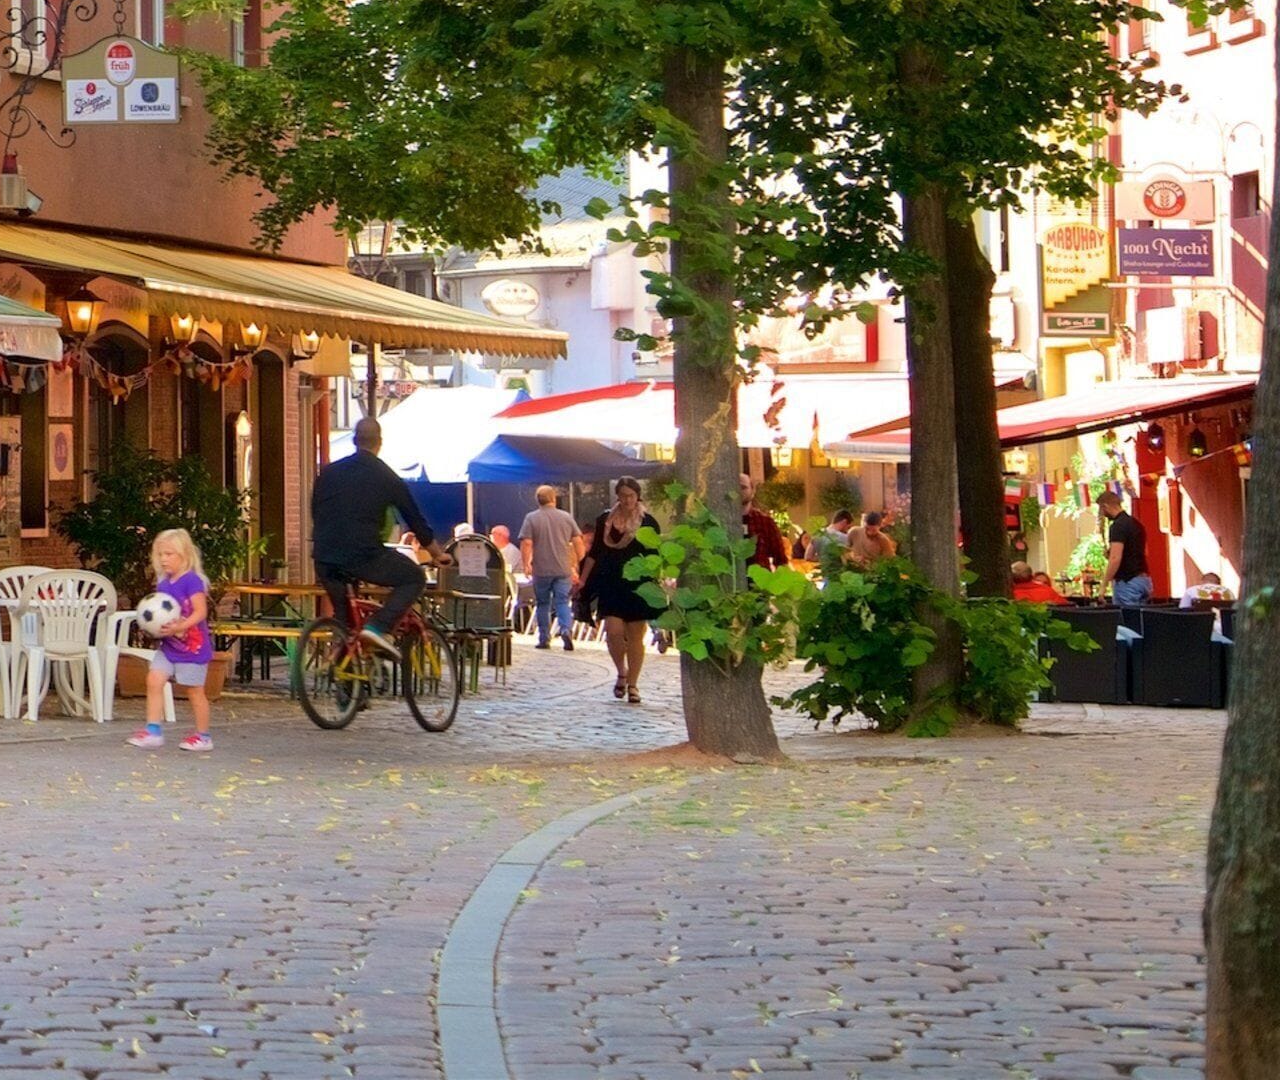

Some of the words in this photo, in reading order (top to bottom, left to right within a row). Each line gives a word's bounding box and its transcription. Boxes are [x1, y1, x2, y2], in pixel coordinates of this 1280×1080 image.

[1047, 226, 1105, 251] MABUHAY
[1123, 243, 1150, 255] 1001
[1151, 237, 1209, 261] Nacht
